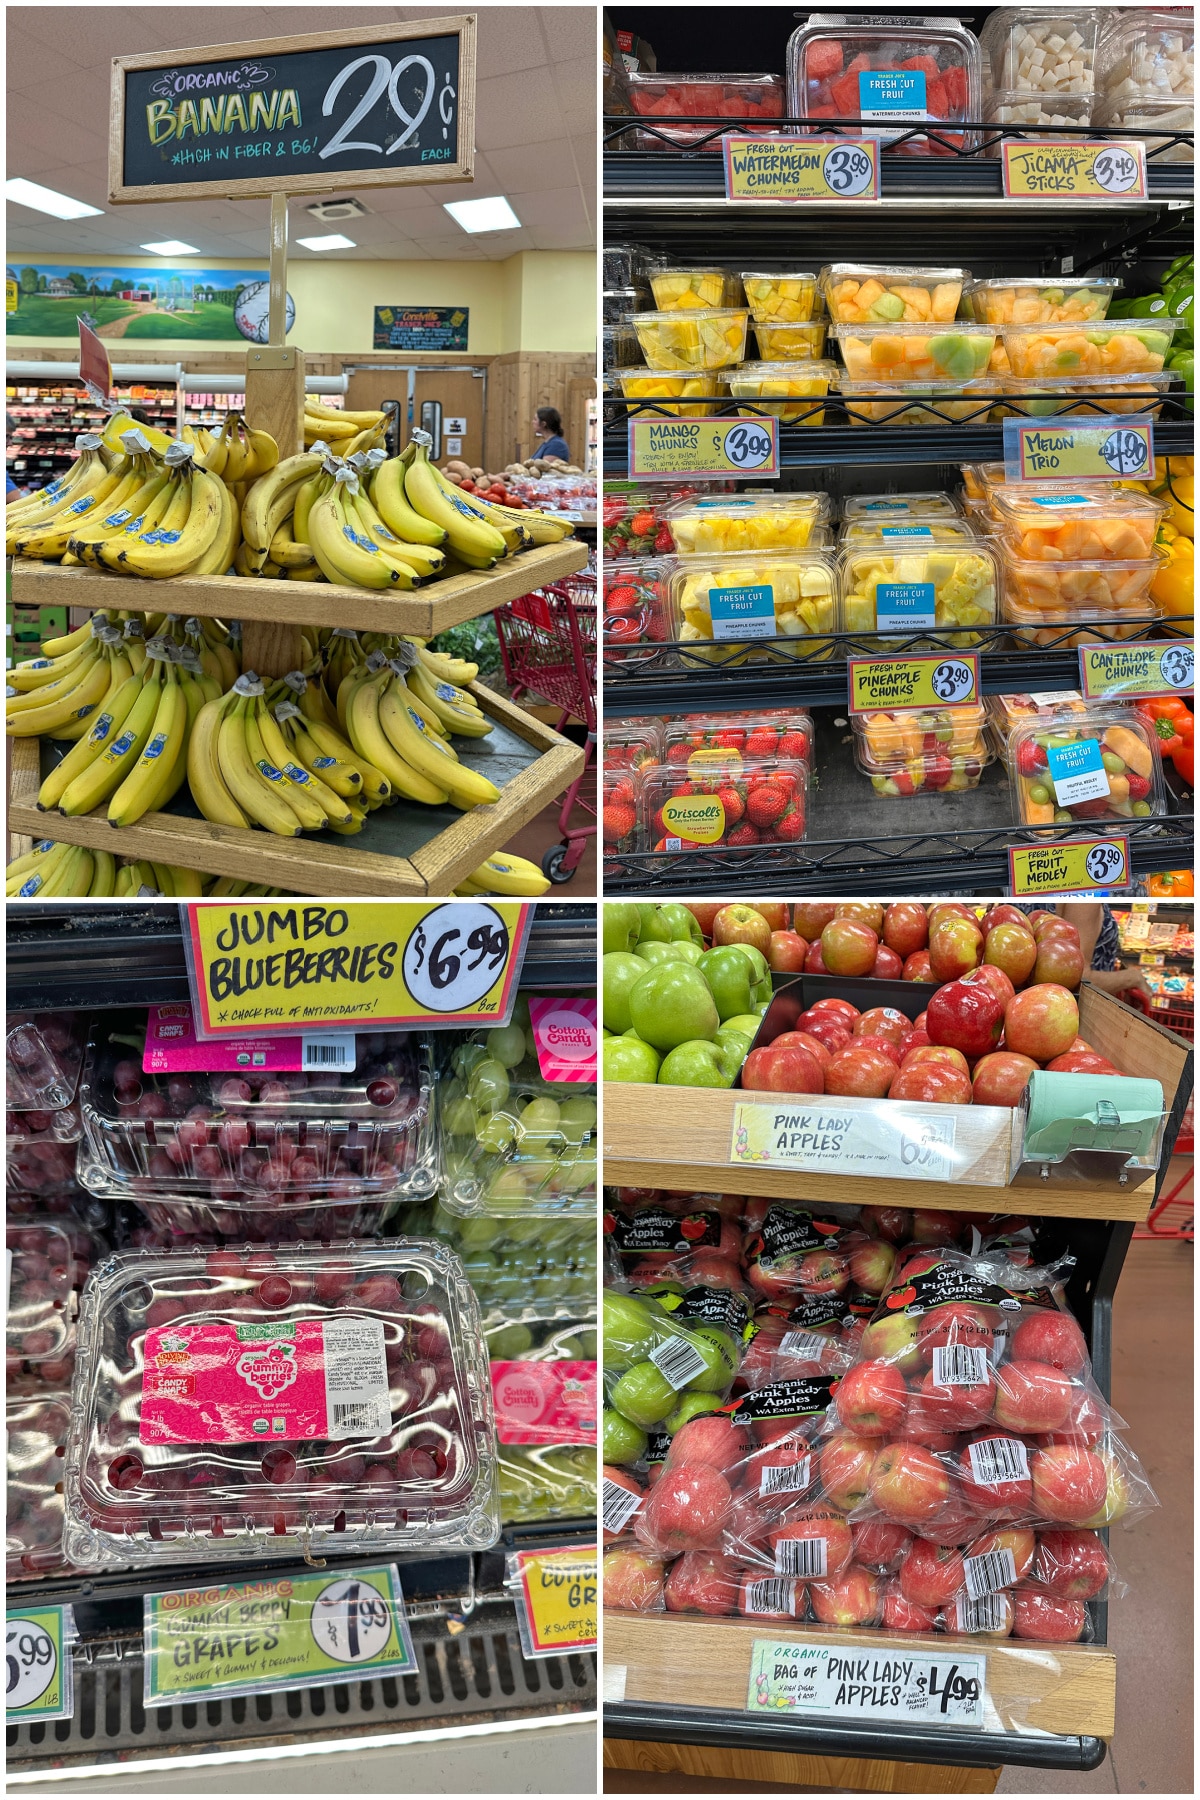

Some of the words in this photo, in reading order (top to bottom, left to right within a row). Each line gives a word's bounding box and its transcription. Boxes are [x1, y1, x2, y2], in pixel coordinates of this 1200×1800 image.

[174, 70, 241, 93] ORGANIC
[870, 80, 897, 88] FRESH
[900, 80, 914, 88] CUT
[882, 90, 904, 98] FRUIT
[146, 90, 302, 147] BANANA
[216, 147, 229, 159] IN
[235, 142, 271, 158] FIBER
[276, 143, 286, 156] &
[291, 137, 317, 154] B6!
[421, 148, 450, 161] EACH
[746, 144, 775, 154] FRESH
[779, 144, 794, 152] CUT
[733, 154, 820, 174] WATERMELON
[747, 171, 800, 186] CHUNKS
[650, 425, 700, 439] MANGO
[650, 437, 698, 451] CHUNKS
[1025, 433, 1074, 452] MELON
[1026, 453, 1060, 471] TRIO
[720, 594, 745, 602] FRESH
[748, 592, 763, 600] CUT
[731, 602, 753, 610] FRUIT
[1091, 650, 1156, 670] CANTALOPE
[869, 664, 893, 674] FRESH
[895, 663, 908, 671] CUT
[1105, 663, 1149, 680] CHUNKS
[859, 670, 921, 690] PINEAPPLE
[870, 684, 914, 698] CHUNKS
[1056, 751, 1077, 762] FRESH
[1079, 747, 1091, 756] CUT
[1066, 758, 1085, 768] FRUIT
[667, 806, 721, 819] Driscoll's
[1028, 850, 1049, 859] FRESH
[1029, 857, 1064, 872] FRUIT
[1027, 866, 1068, 885] MEDLEY
[216, 907, 349, 952] JUMBO
[414, 924, 511, 989] $6.99
[209, 941, 398, 1002] BLUEBERRIES
[231, 1007, 262, 1021] CHOCK
[265, 1006, 284, 1018] FULL
[289, 1005, 301, 1016] OF
[303, 999, 378, 1017] ANTIOXIDANTS!
[548, 1024, 587, 1035] Cotton
[547, 1034, 592, 1047] Candy
[774, 1115, 811, 1129] PINK
[818, 1116, 853, 1132] LADY
[776, 1132, 843, 1151] APPLES
[629, 1228, 664, 1238] Apples
[763, 1221, 786, 1239] Pink
[922, 1279, 953, 1290] Pink
[936, 1284, 984, 1295] Apples
[928, 1295, 942, 1304] WA
[910, 1330, 924, 1338] NET
[976, 1327, 989, 1335] LB)
[241, 1362, 289, 1373] Gummy
[158, 1379, 187, 1387] CANDY
[251, 1372, 291, 1381] berries
[158, 1386, 188, 1394] SNAPS
[504, 1386, 535, 1396] Cotton
[765, 1379, 807, 1389] Organic
[750, 1388, 782, 1400] Pink
[786, 1386, 822, 1396] Lady
[763, 1396, 810, 1407] Apples
[157, 1414, 164, 1422] lb
[150, 1429, 163, 1437] 907
[161, 1579, 293, 1610] ORGANIC
[166, 1609, 230, 1637] GUMMY
[554, 1619, 583, 1632] SWEET
[174, 1625, 280, 1668] GRAPES
[774, 1647, 829, 1659] ORGANIC
[183, 1669, 210, 1683] SWEET
[223, 1663, 257, 1677] GUMMY
[773, 1664, 798, 1681] BAG
[804, 1666, 818, 1678] OF
[827, 1657, 870, 1682] PINK
[873, 1660, 913, 1686] LADY
[782, 1684, 796, 1692] HIGH
[797, 1684, 814, 1692] SUGAR
[835, 1683, 902, 1707] APPLES
